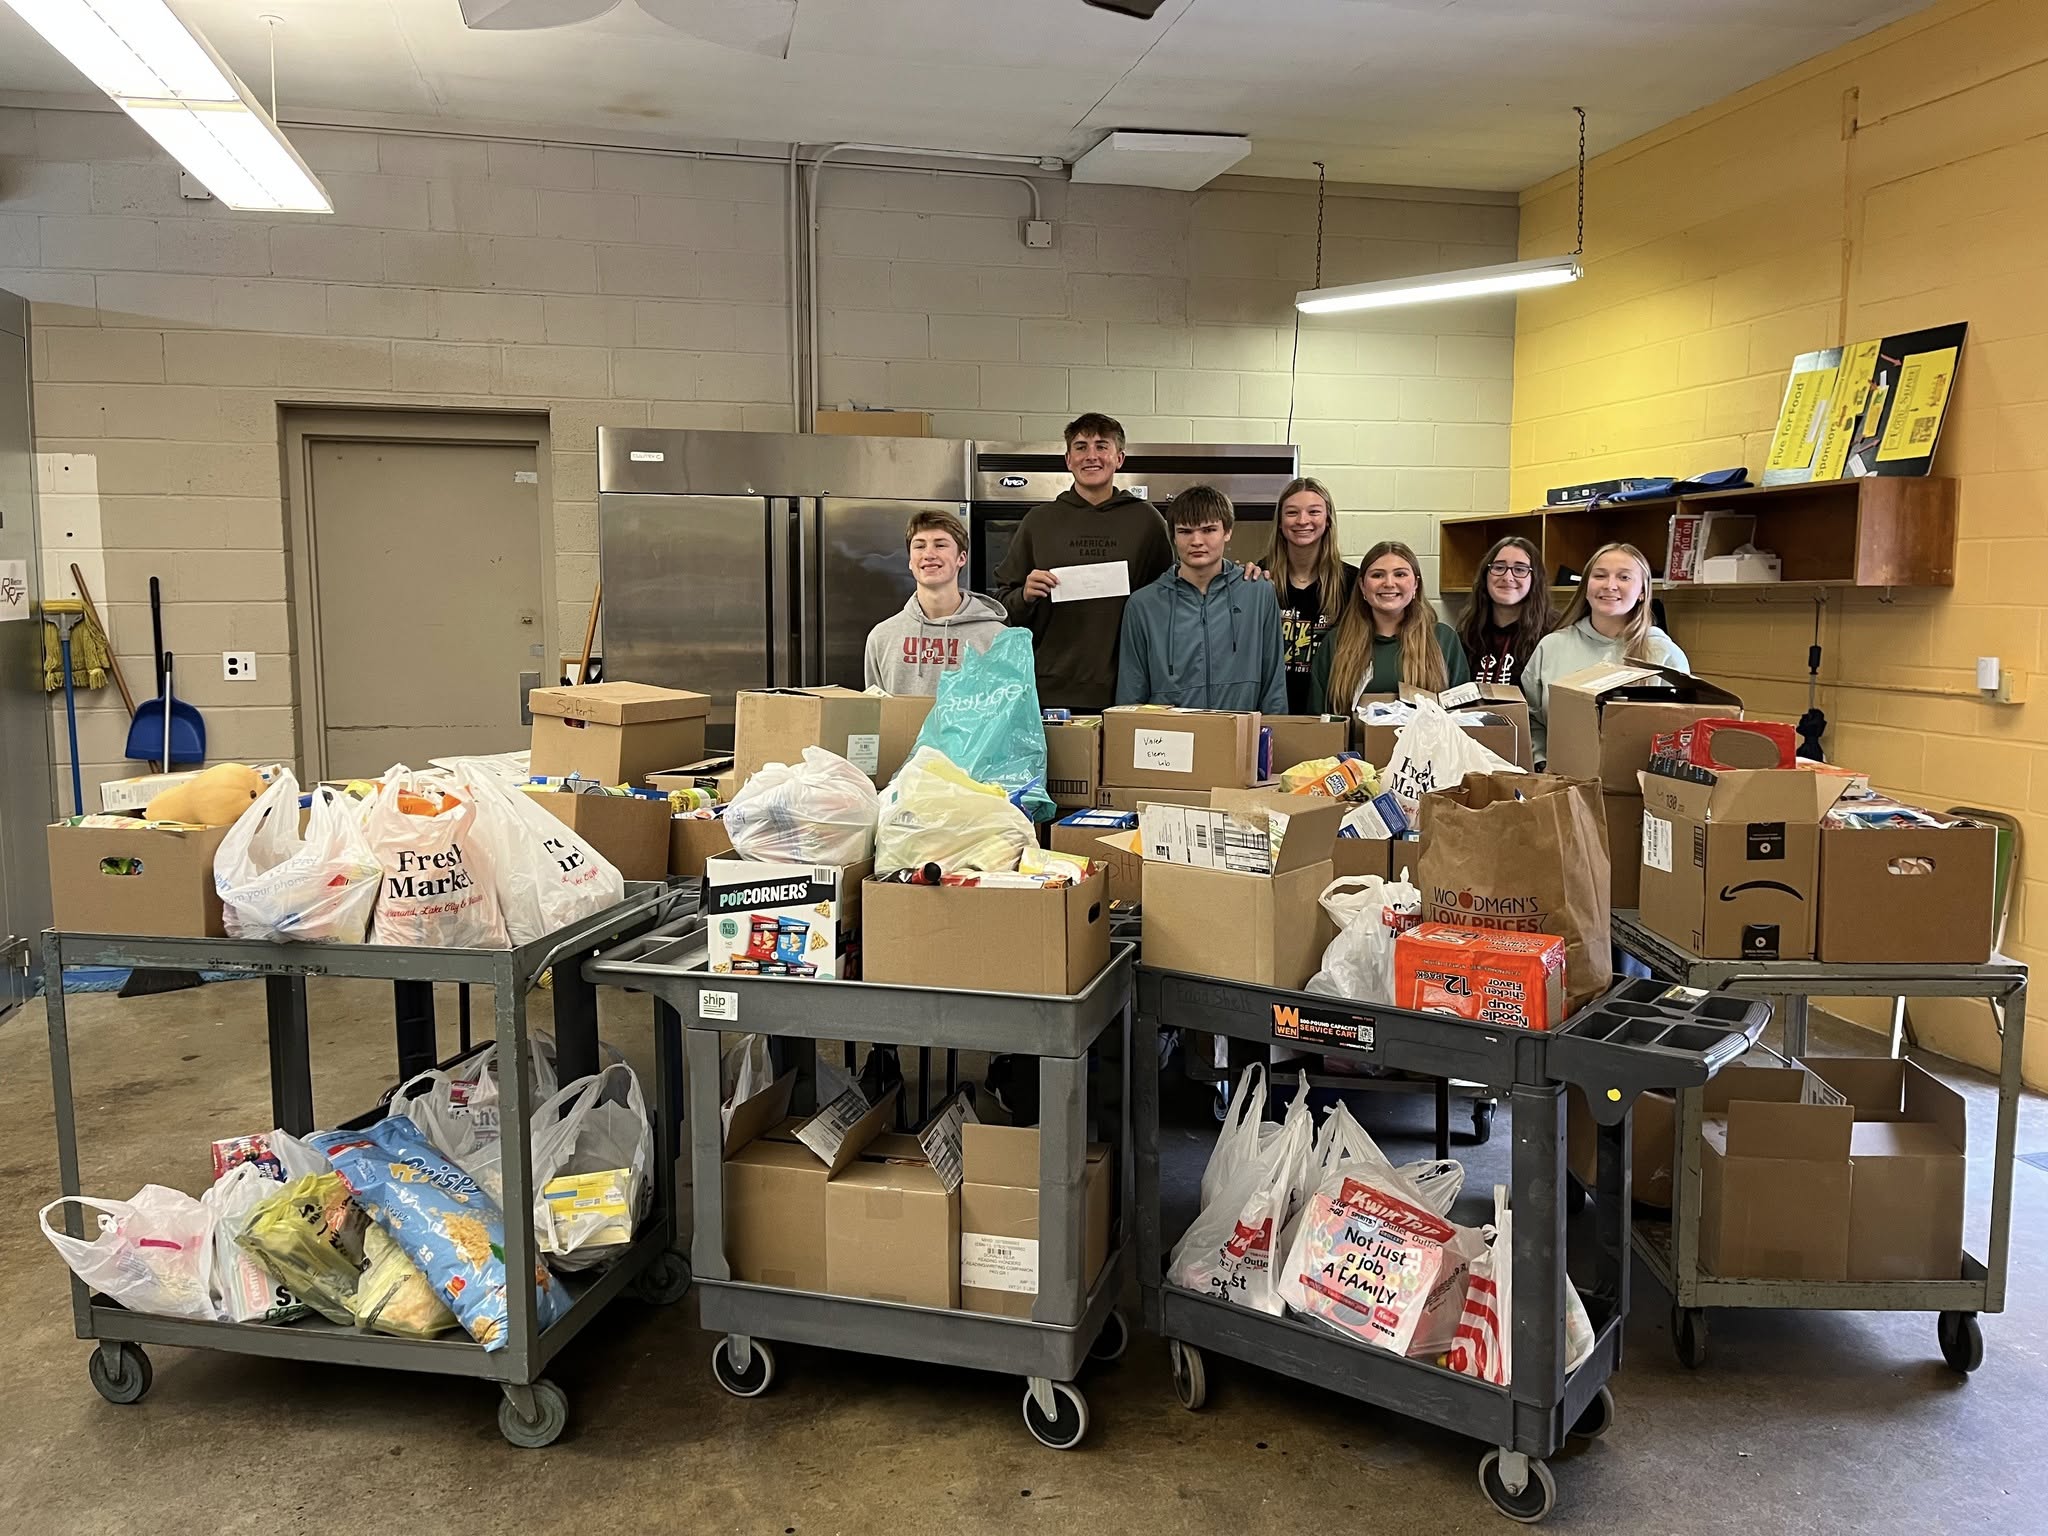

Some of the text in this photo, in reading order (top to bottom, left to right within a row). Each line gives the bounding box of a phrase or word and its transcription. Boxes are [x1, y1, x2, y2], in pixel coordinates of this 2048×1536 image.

[1773, 382, 1805, 465] Five for Food
[1815, 420, 1839, 478] Sponsors
[1069, 539, 1117, 548] AMERICAN
[1079, 549, 1108, 557] EAGLE
[903, 636, 959, 657] UTAH
[388, 868, 474, 900] Market
[247, 886, 271, 900] your
[719, 882, 808, 908] POPCORNERS
[420, 903, 444, 916] Lake
[1432, 907, 1467, 925] LOW
[1472, 916, 1539, 934] PRICES
[1415, 971, 1473, 998] 12 PACK
[1488, 978, 1522, 991] Flavor
[703, 993, 726, 1007] ship
[1483, 986, 1526, 1001] Chicken
[1488, 999, 1522, 1014] Soup
[1482, 1009, 1529, 1027] Noodle
[1277, 1026, 1297, 1036] WEN
[1300, 1023, 1334, 1035] SERVICE
[1335, 1029, 1357, 1039] CART
[1330, 1023, 1358, 1031] CAPACITY
[1350, 1210, 1376, 1226] SPIRITS
[1382, 1221, 1407, 1236] Outlet
[1344, 1226, 1408, 1266] Not just
[1346, 1253, 1387, 1281] a job,
[1323, 1262, 1334, 1278] A
[1337, 1266, 1398, 1305] FAMILY
[1371, 1322, 1396, 1337] careers
